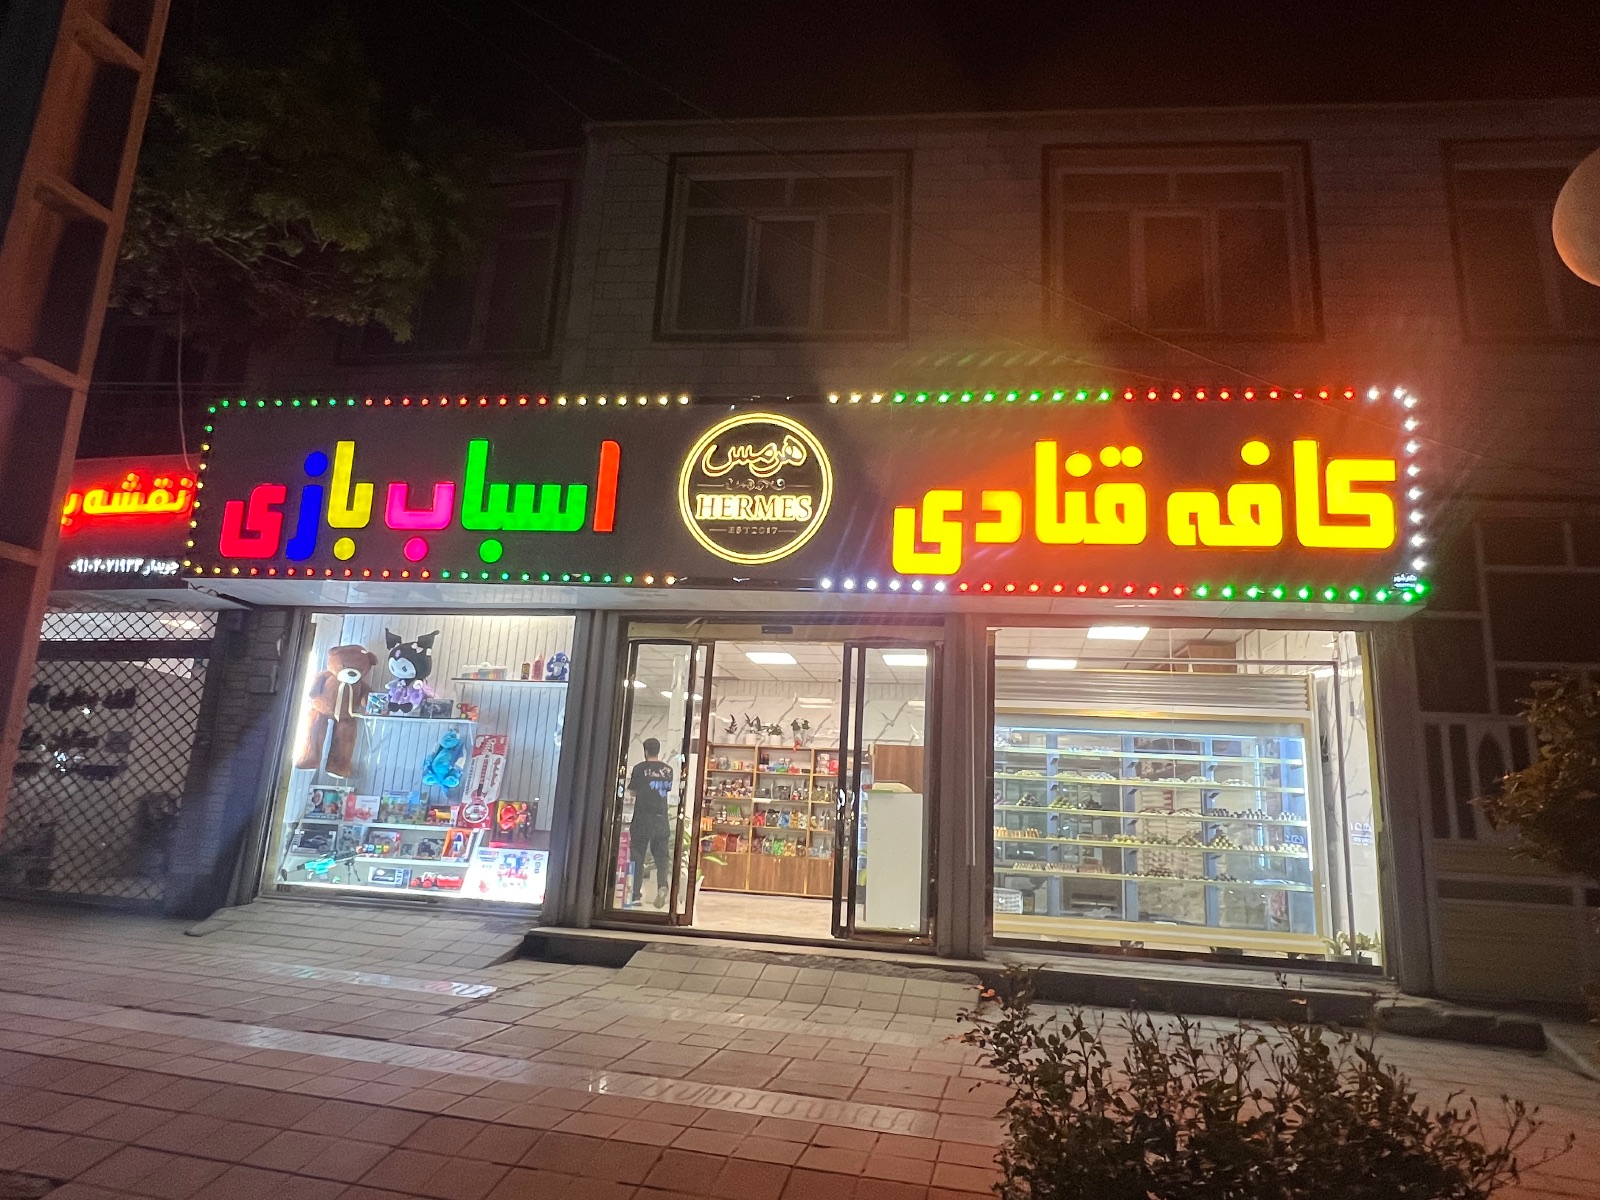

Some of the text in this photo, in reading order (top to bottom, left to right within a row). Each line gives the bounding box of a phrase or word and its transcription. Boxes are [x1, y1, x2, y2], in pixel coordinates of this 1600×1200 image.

[701, 434, 807, 478] هرمس
[83, 473, 193, 515] نقشه
[219, 438, 621, 563] اسباب بازی
[695, 493, 812, 522] HERMES
[892, 439, 1397, 576] کافه قنادی
